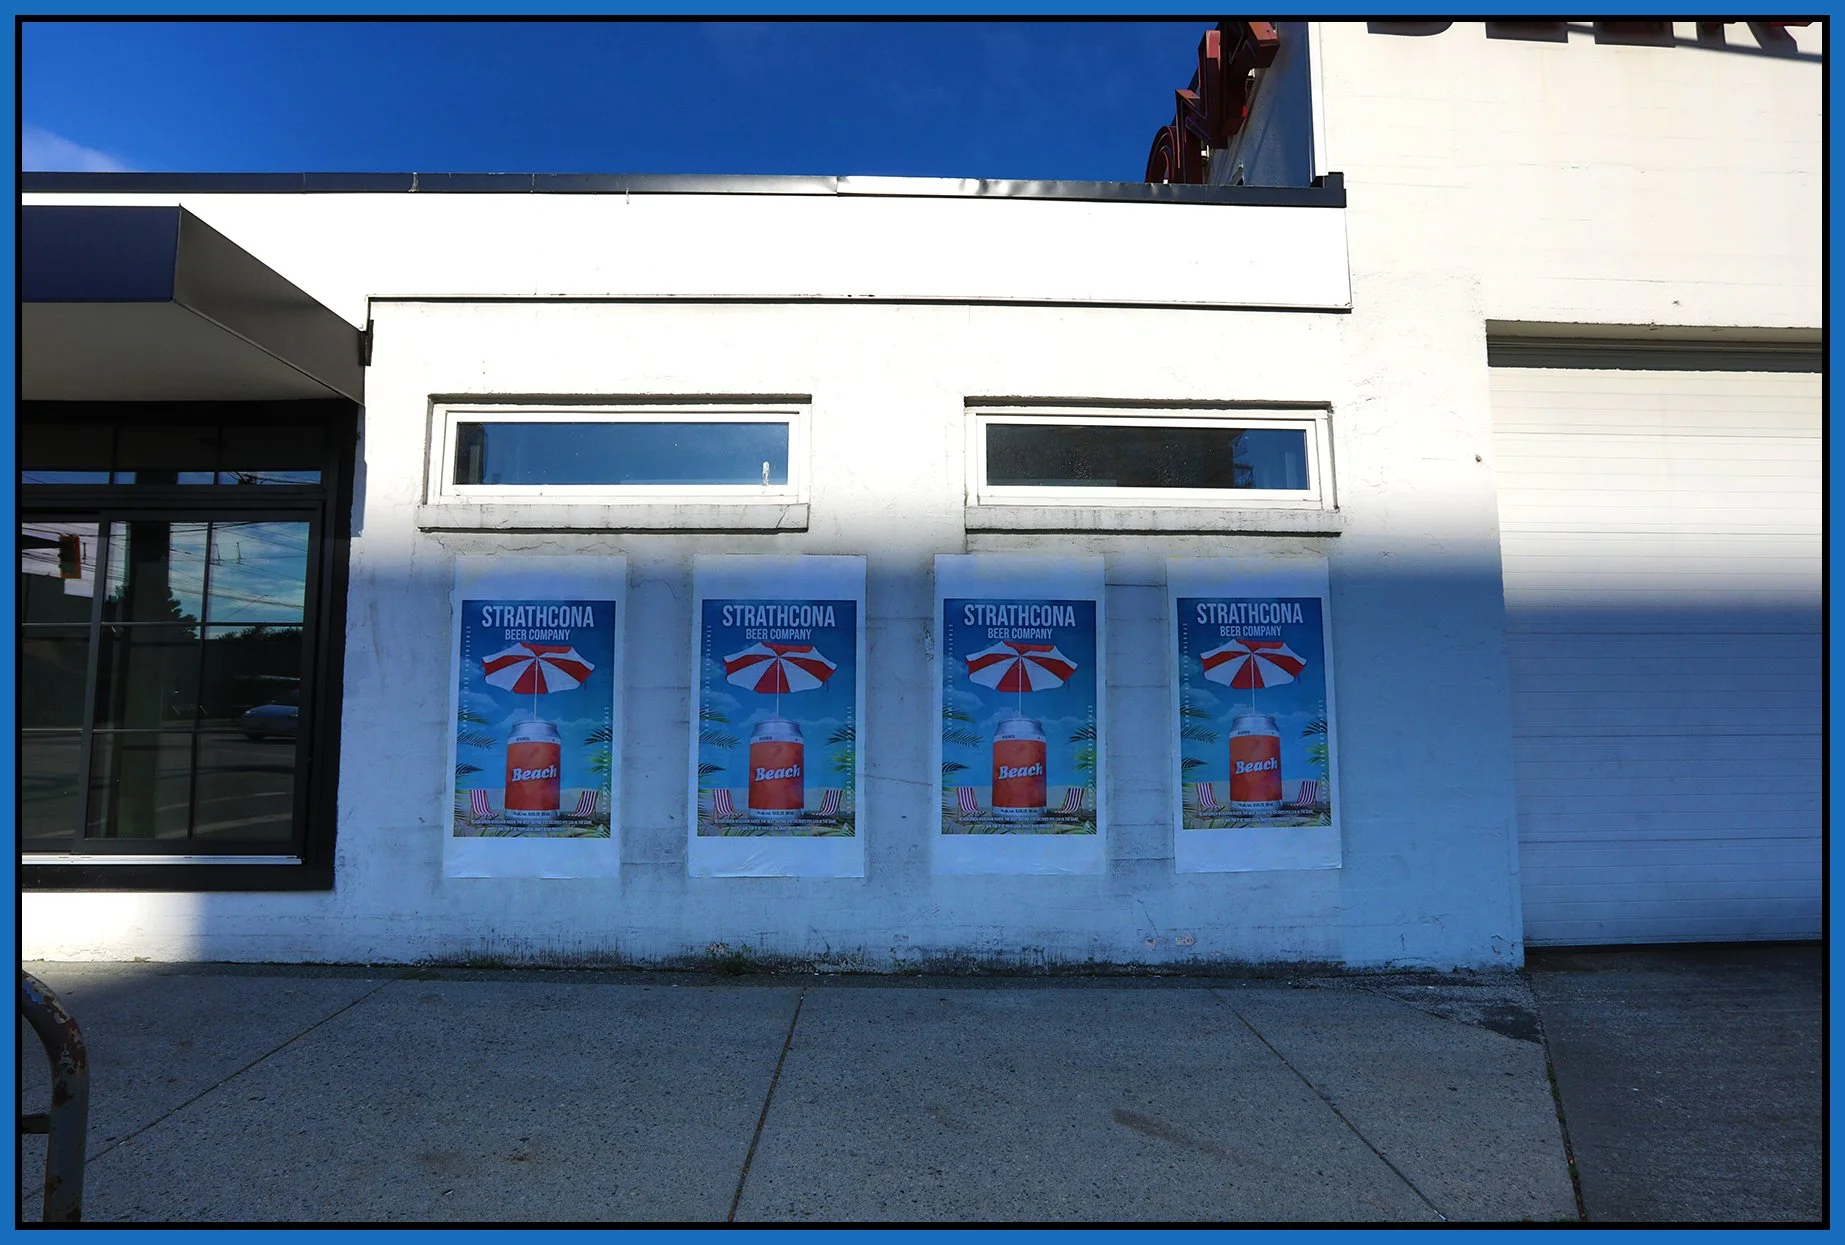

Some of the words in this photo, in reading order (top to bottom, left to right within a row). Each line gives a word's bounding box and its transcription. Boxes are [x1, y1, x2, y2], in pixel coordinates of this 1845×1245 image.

[481, 605, 595, 628] STRATHCONA
[722, 604, 836, 627] STRATHCONA
[963, 604, 1076, 627] STRATHCONA
[1196, 602, 1304, 624] STRATHCONA
[504, 629, 527, 641] BEER
[528, 629, 571, 641] COMPANY
[745, 628, 768, 640] BEER
[770, 628, 812, 640] COMPANY
[987, 627, 1010, 639] BEER
[1011, 628, 1053, 640] COMPANY
[1219, 625, 1241, 637] BEER
[1242, 625, 1282, 637] COMPANY
[511, 764, 558, 782] Beach
[755, 764, 801, 782] Beach
[998, 762, 1043, 780] Beach
[1235, 756, 1278, 775] Beach
